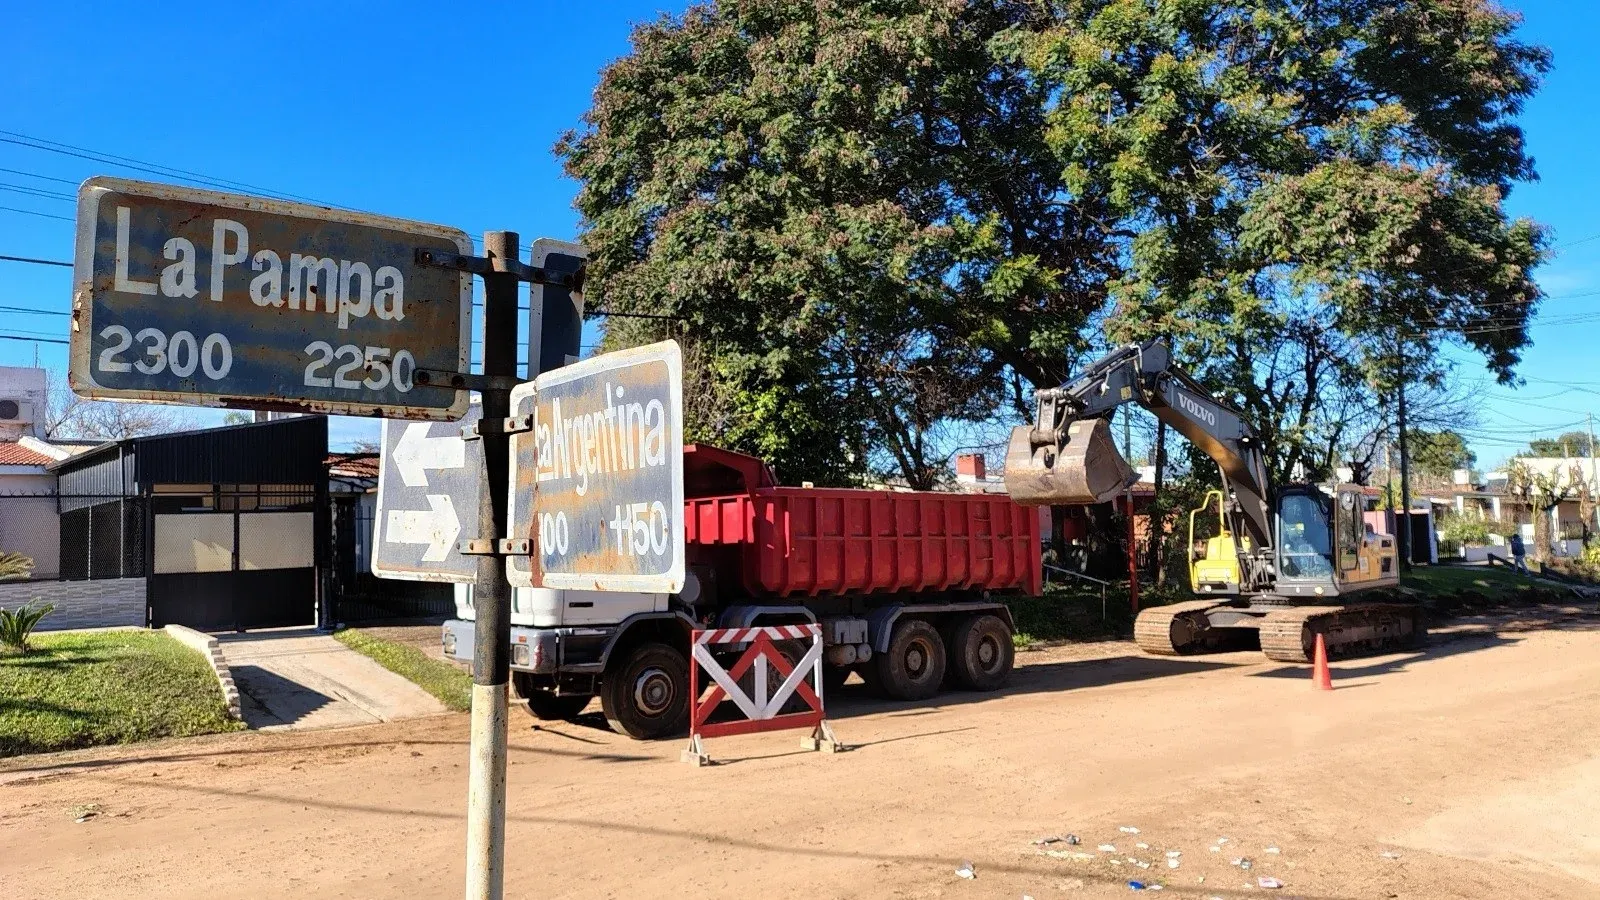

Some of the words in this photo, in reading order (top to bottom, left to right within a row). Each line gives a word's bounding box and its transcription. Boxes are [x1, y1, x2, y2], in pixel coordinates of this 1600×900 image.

[114, 206, 199, 298] La
[210, 219, 406, 329] Pampa
[98, 324, 233, 381] 2300
[303, 340, 416, 393] 2250
[552, 382, 666, 496] Argentina
[1177, 392, 1216, 426] VOLVO
